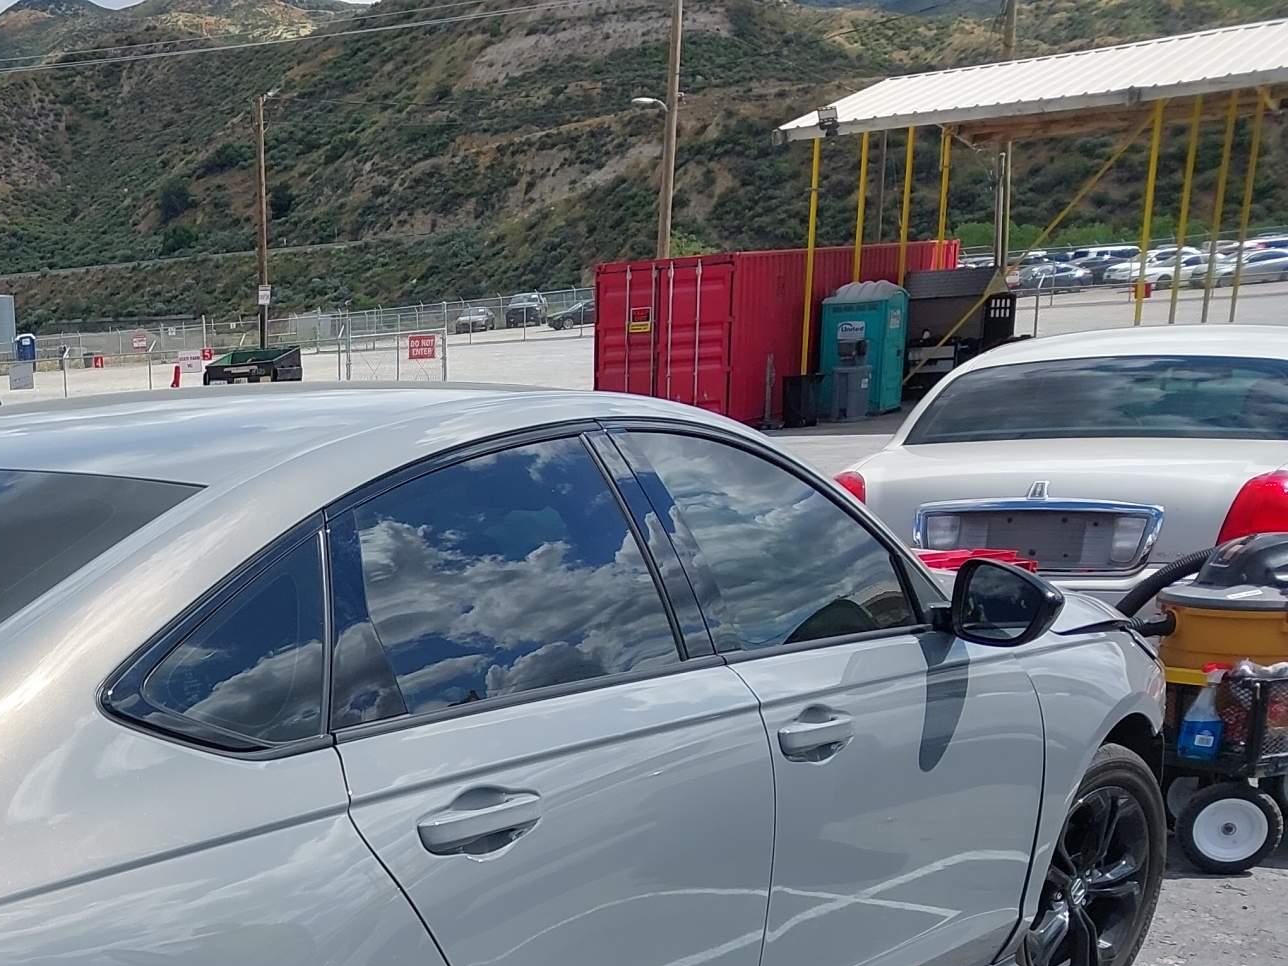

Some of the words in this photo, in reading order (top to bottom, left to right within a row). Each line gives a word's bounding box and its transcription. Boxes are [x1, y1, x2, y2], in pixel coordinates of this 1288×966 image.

[410, 340, 419, 348] DO
[421, 339, 434, 347] NOT
[412, 347, 433, 356] ENTER
